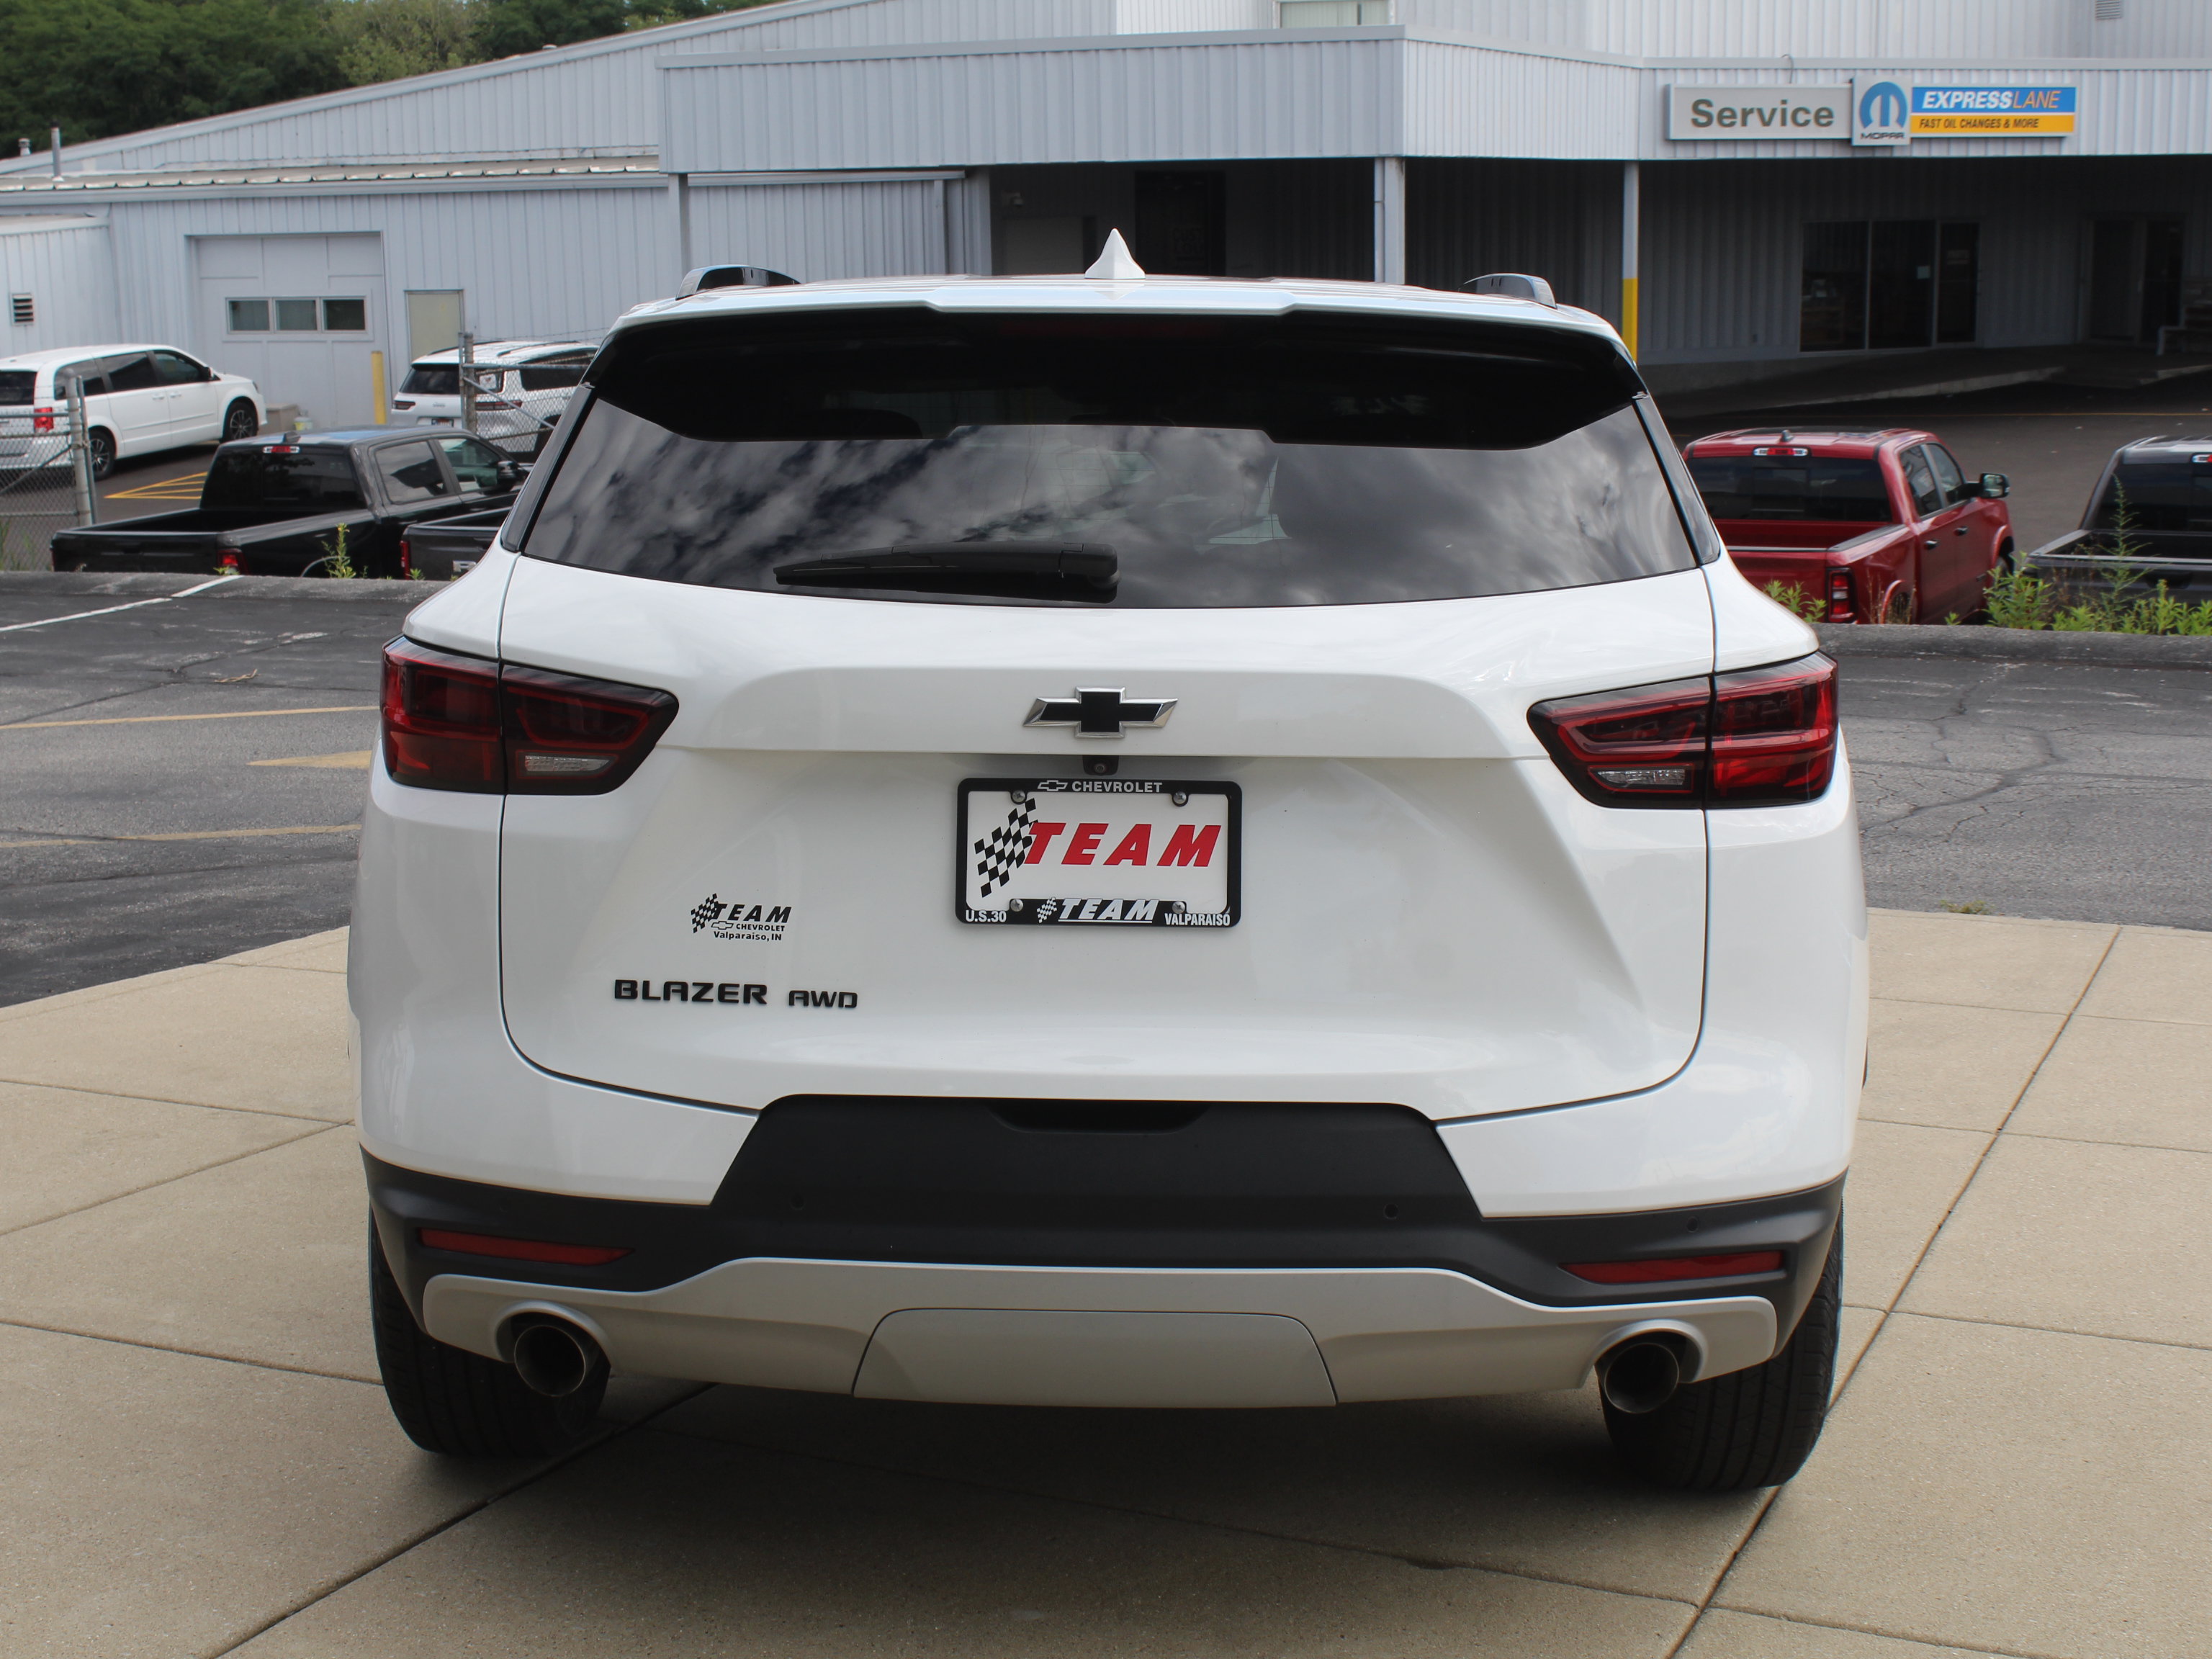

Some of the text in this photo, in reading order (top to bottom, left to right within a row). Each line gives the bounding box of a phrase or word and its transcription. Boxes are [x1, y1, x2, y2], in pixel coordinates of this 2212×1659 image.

[1690, 98, 1835, 128] Service
[1919, 118, 2039, 129] FAST OIL CHANGES & MORE
[1071, 781, 1163, 793] CHEVROLET
[1023, 822, 1222, 867] TEAM
[710, 903, 792, 923] TEAM
[1058, 898, 1159, 921] TEAM
[736, 923, 786, 932] CHEVROLET
[1164, 912, 1231, 927] VALPARAISO
[714, 930, 770, 942] Valparaiso,
[614, 979, 858, 1009] BLAZER AWD
